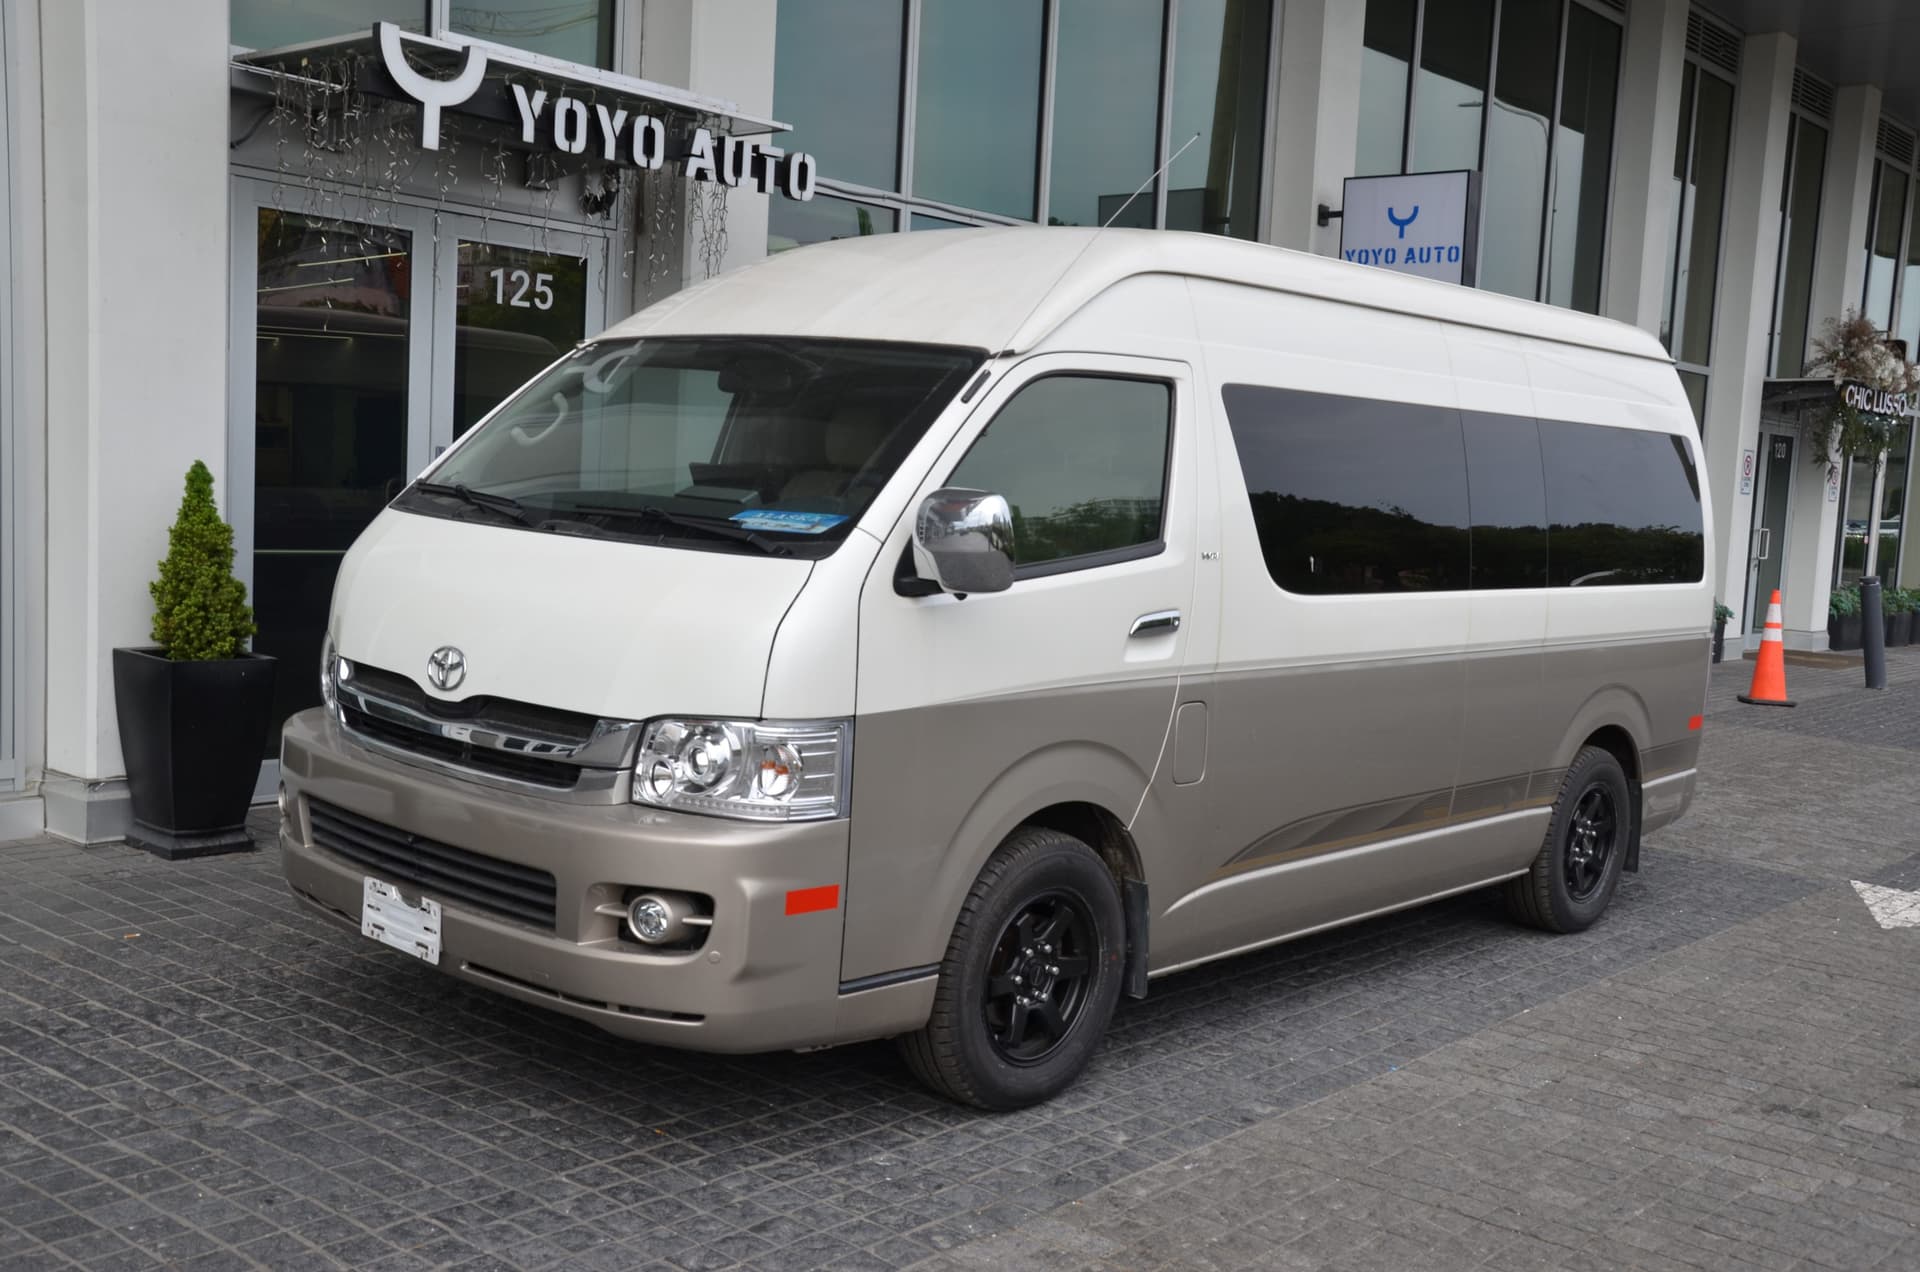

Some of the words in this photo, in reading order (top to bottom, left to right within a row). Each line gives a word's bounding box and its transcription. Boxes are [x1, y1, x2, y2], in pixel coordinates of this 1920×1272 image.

[511, 83, 665, 170] YOYO
[686, 128, 817, 202] AUTO
[1345, 247, 1396, 265] YOYO
[1404, 246, 1460, 264] AUTO
[490, 268, 554, 311] 125
[1845, 384, 1873, 411] CHIC
